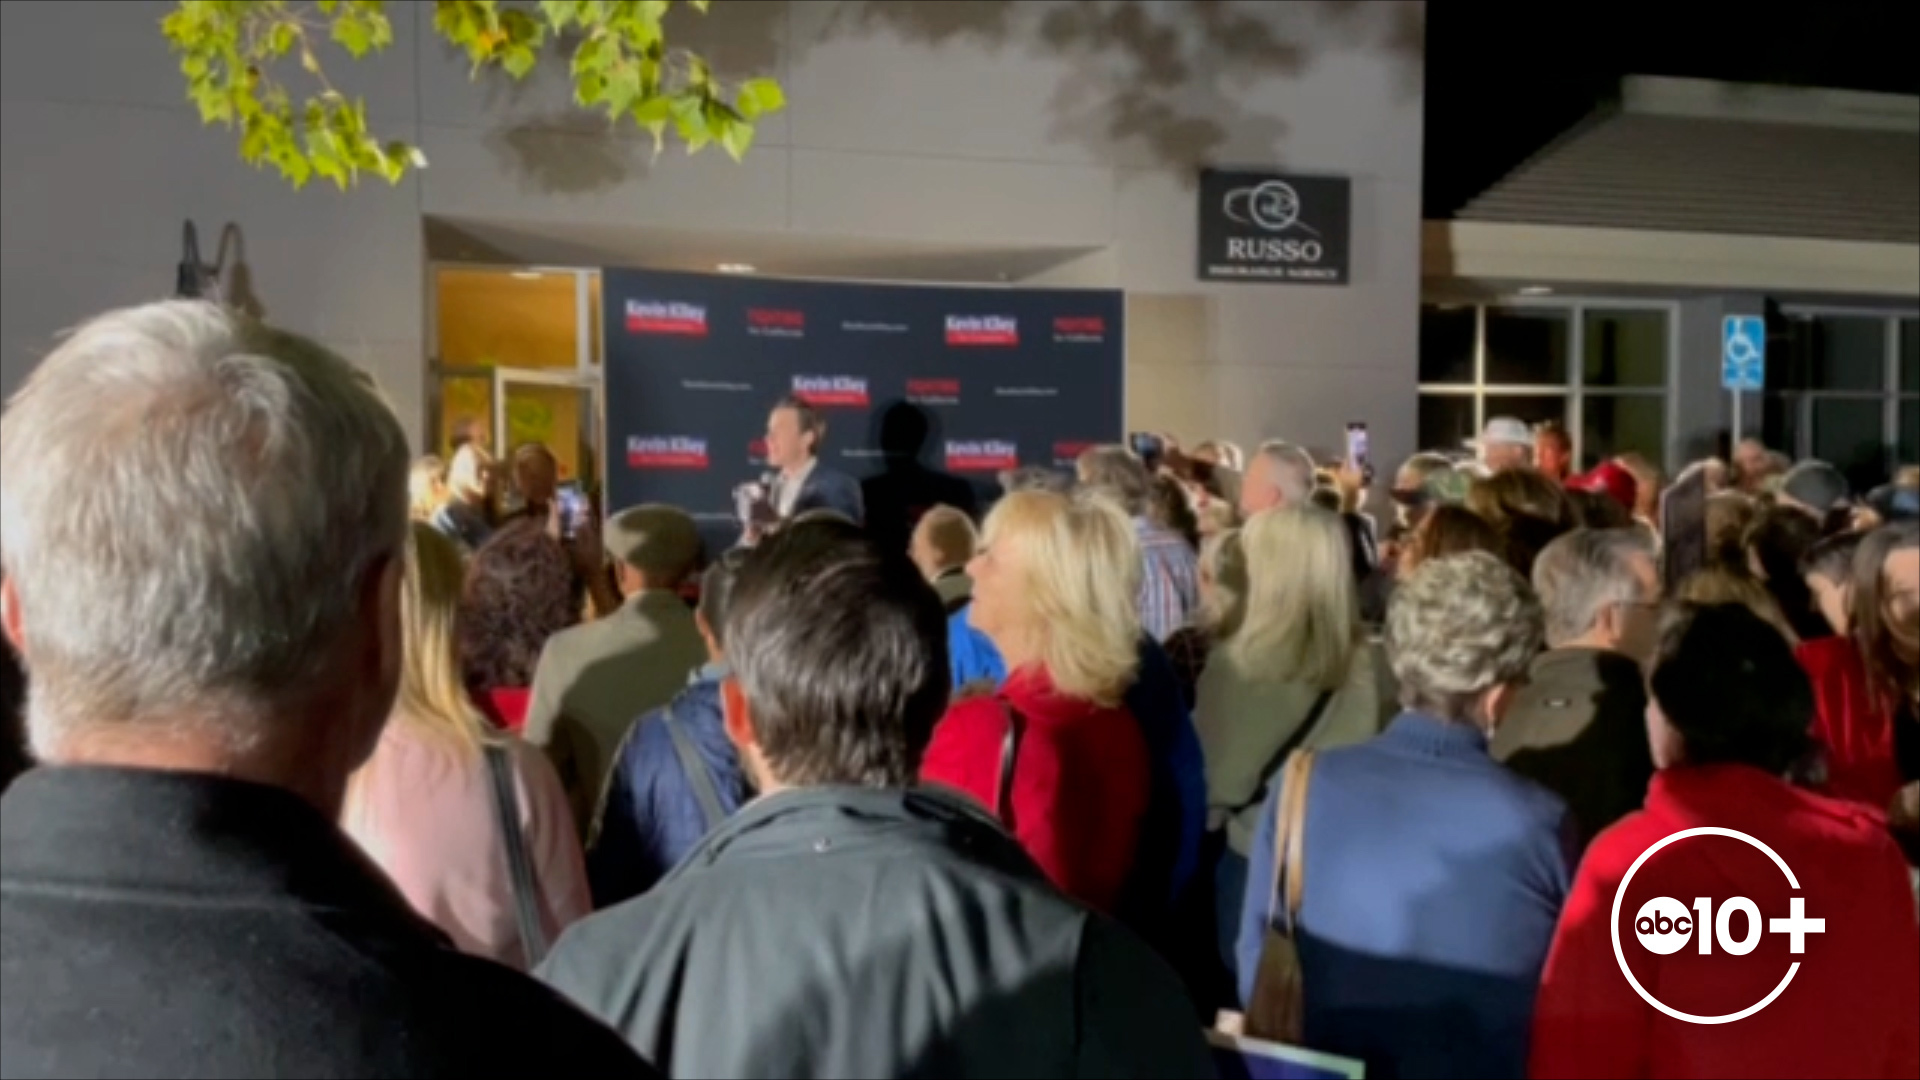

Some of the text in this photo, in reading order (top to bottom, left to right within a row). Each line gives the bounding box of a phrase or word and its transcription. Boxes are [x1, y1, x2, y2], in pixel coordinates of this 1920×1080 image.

[1227, 237, 1323, 262] RUSSO
[625, 299, 707, 323] Kevin Kiley
[945, 314, 1018, 334] Kevin Kiley
[792, 374, 868, 395] Kevin Kiley
[626, 436, 708, 457] Kevin Kiley
[945, 440, 1017, 459] Kevin Kiley
